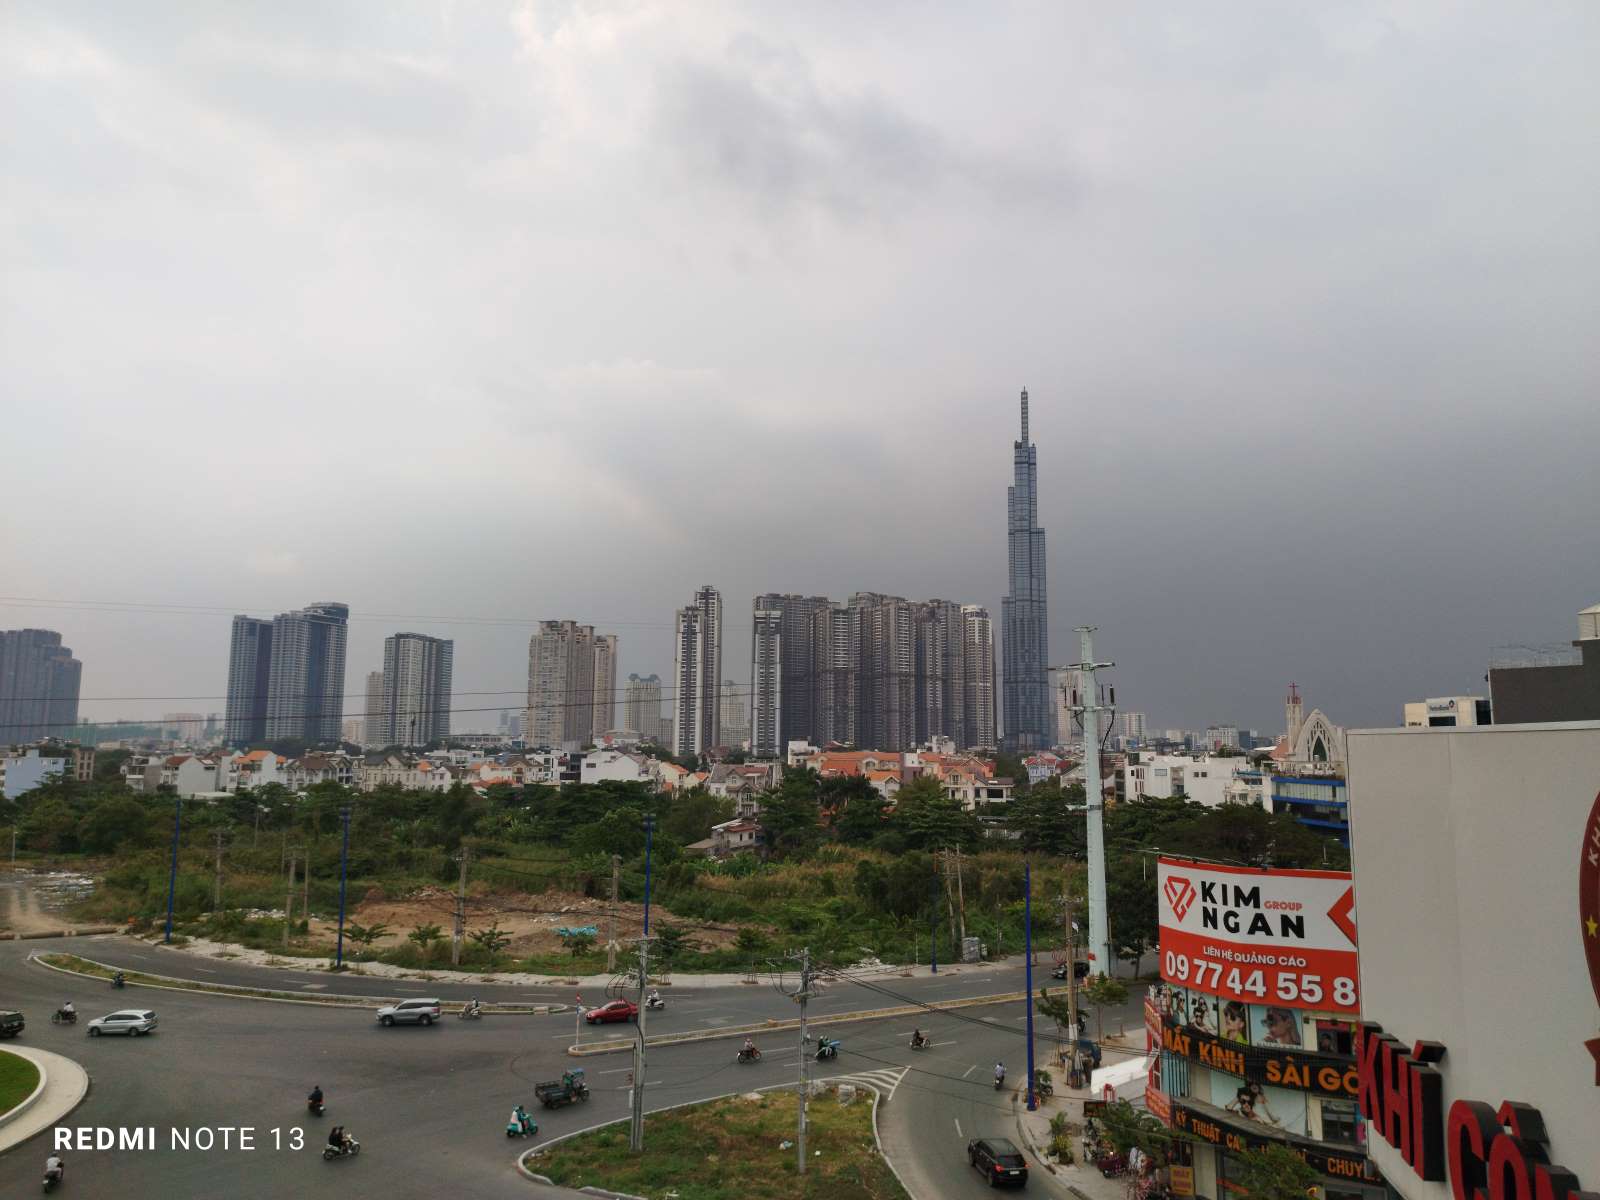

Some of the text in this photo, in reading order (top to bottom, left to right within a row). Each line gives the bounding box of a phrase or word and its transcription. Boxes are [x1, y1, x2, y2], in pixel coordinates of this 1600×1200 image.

[1201, 881, 1261, 909] KIM
[1264, 901, 1303, 912] GROUP
[1202, 906, 1305, 938] NGAN
[1203, 945, 1221, 959] LIÊN
[1221, 948, 1233, 962] HỆ
[1278, 955, 1307, 967] CÁO
[1198, 1039, 1245, 1076] KÍNH
[1265, 1055, 1310, 1088] SÀI
[1318, 1064, 1359, 1096] GÒ
[1354, 1020, 1446, 1182] KHÍ
[1327, 1157, 1371, 1179] CHUY
